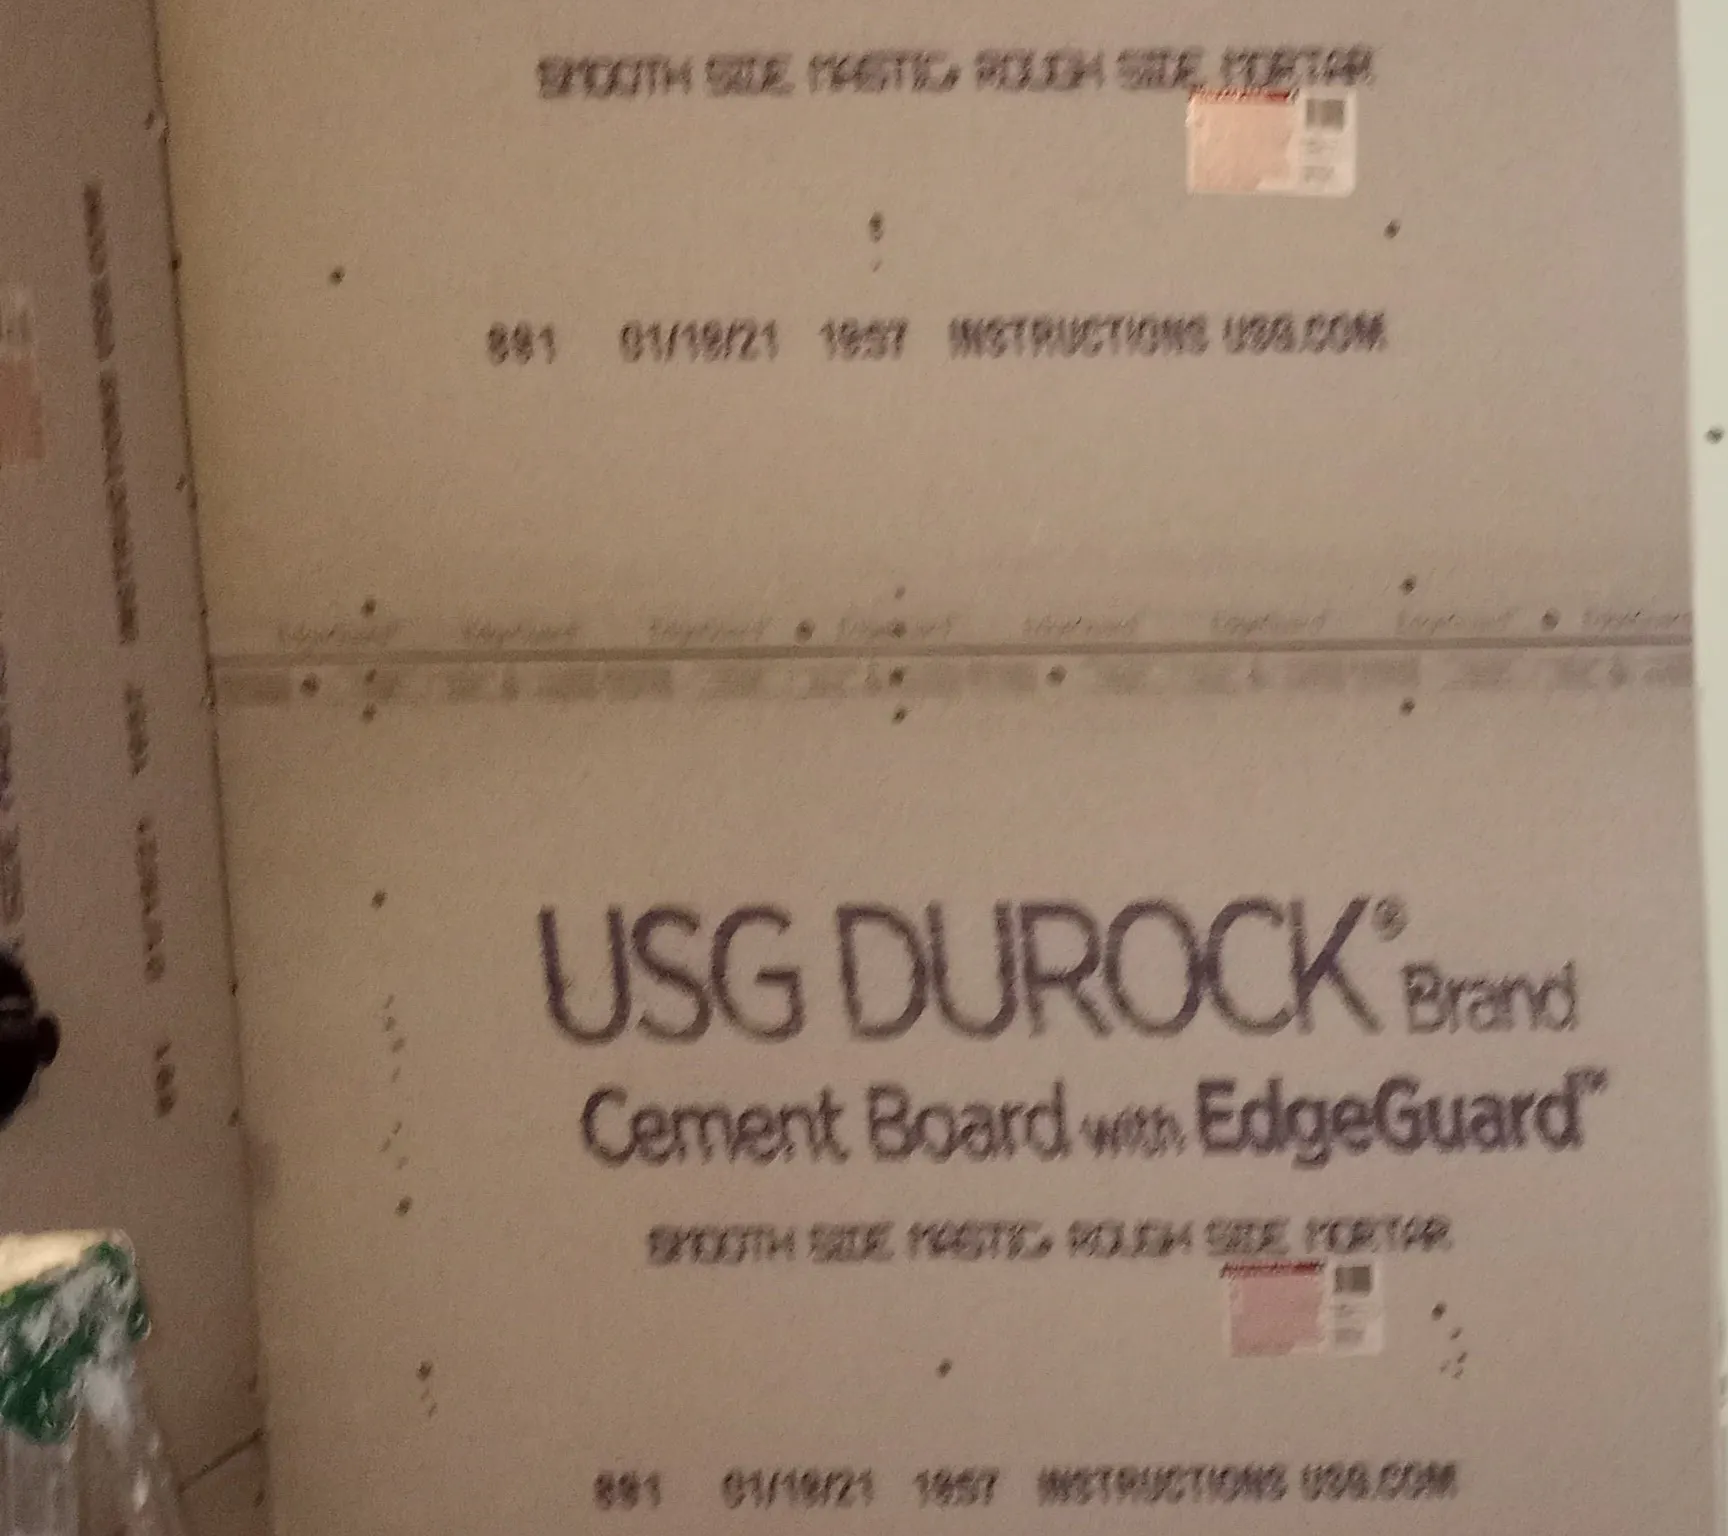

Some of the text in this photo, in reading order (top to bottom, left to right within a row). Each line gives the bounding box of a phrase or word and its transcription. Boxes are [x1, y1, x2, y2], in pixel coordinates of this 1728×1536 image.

[537, 57, 691, 99] SMOOTH
[705, 54, 791, 96] SIDE
[1117, 48, 1204, 92] SIDE
[537, 904, 804, 1046] USG
[1401, 962, 1577, 1033] Brand
[579, 1086, 849, 1167] Cement
[866, 1081, 1072, 1162] Board
[1079, 1106, 1186, 1157] with
[647, 1226, 795, 1265] SMOOTH
[808, 1222, 894, 1263] SIDE
[1204, 1218, 1289, 1259] SIDE
